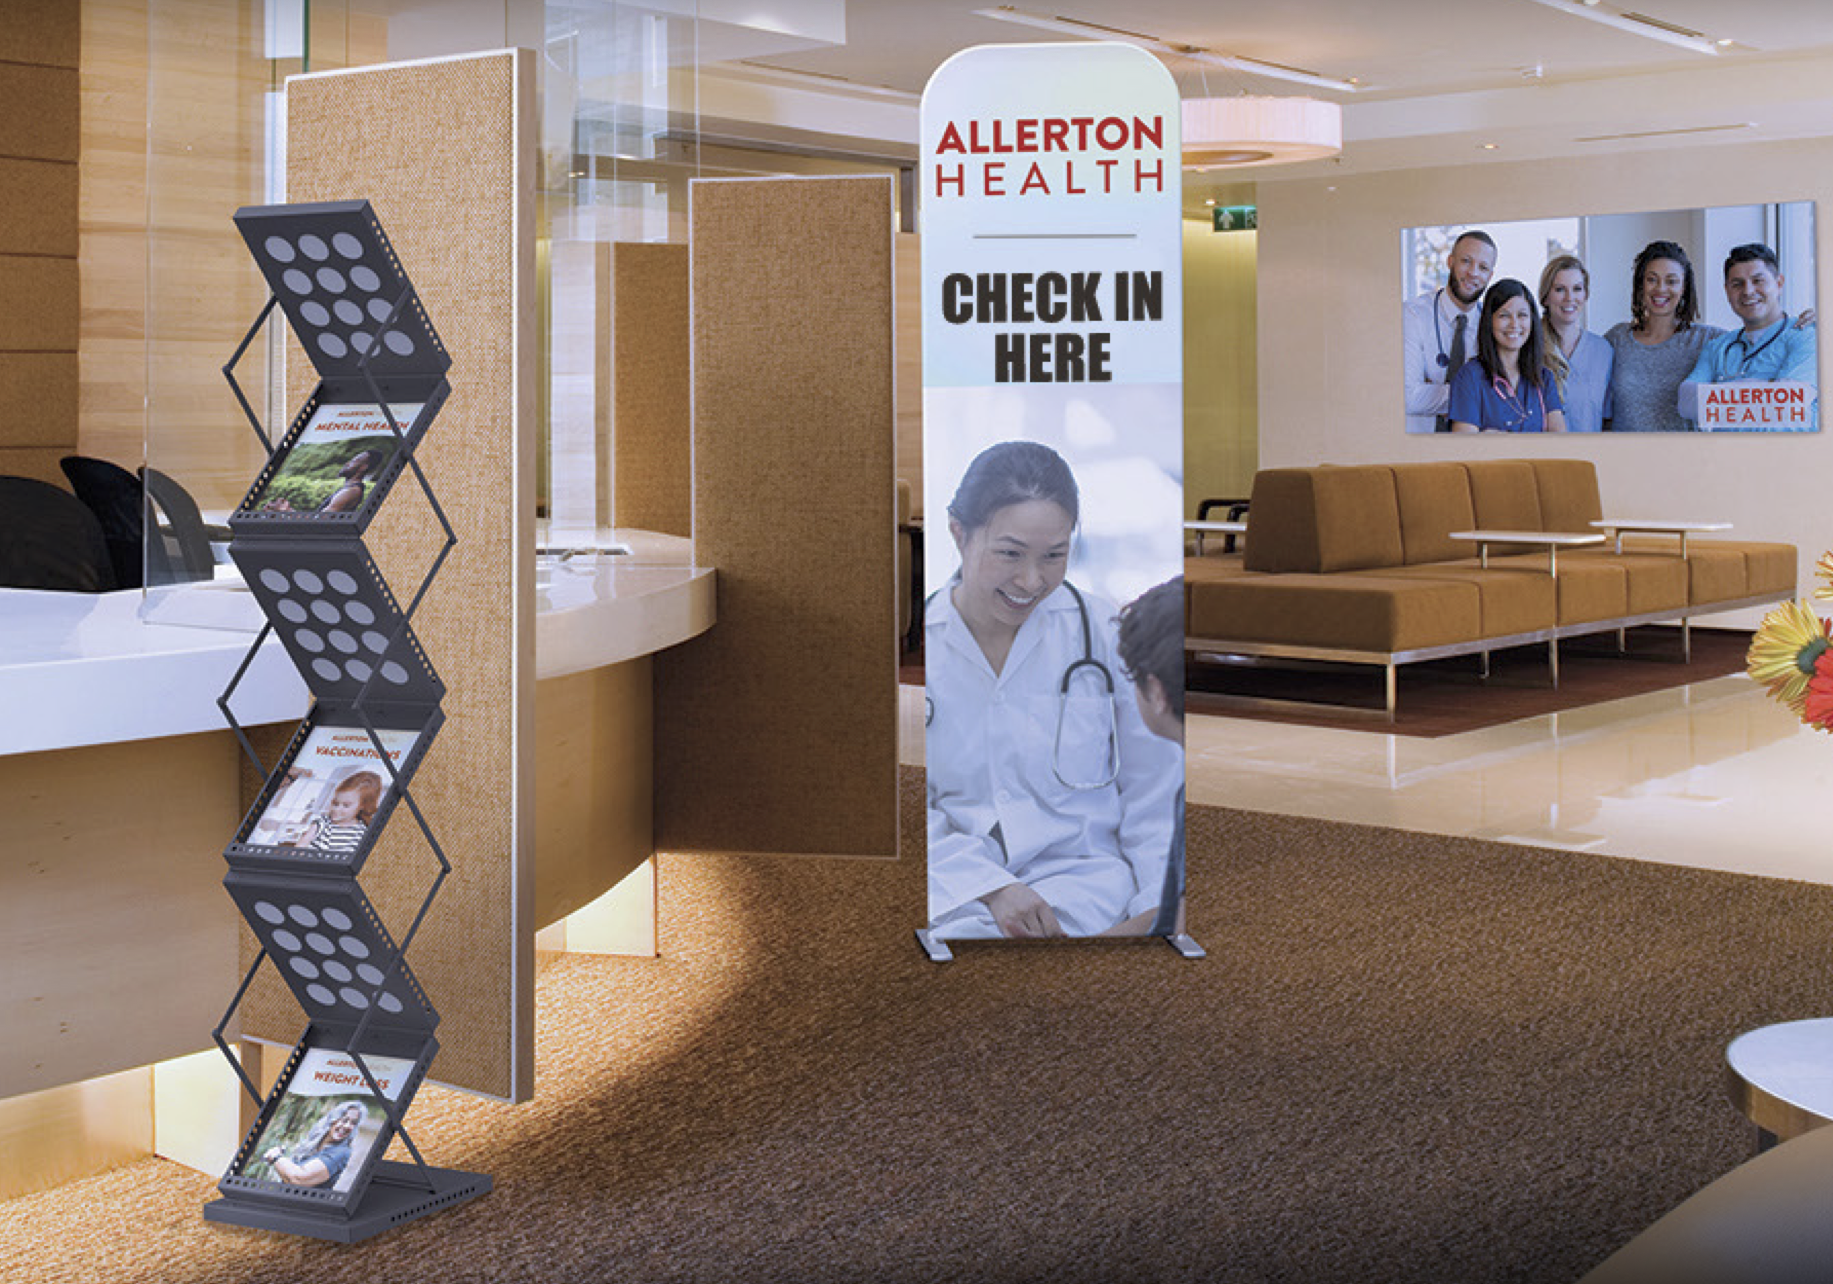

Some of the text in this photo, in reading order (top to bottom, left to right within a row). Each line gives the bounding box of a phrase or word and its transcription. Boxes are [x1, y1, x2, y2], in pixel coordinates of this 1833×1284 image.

[935, 115, 1163, 155] ALLERTON
[935, 158, 1163, 197] HEALTH
[942, 271, 1163, 325] CHECK IN
[995, 332, 1112, 383] HERE
[1706, 388, 1804, 404] ALLERTON
[315, 421, 360, 430] MENTAL
[1706, 406, 1805, 422] HEALTH
[315, 1071, 360, 1085] WEIGHT
